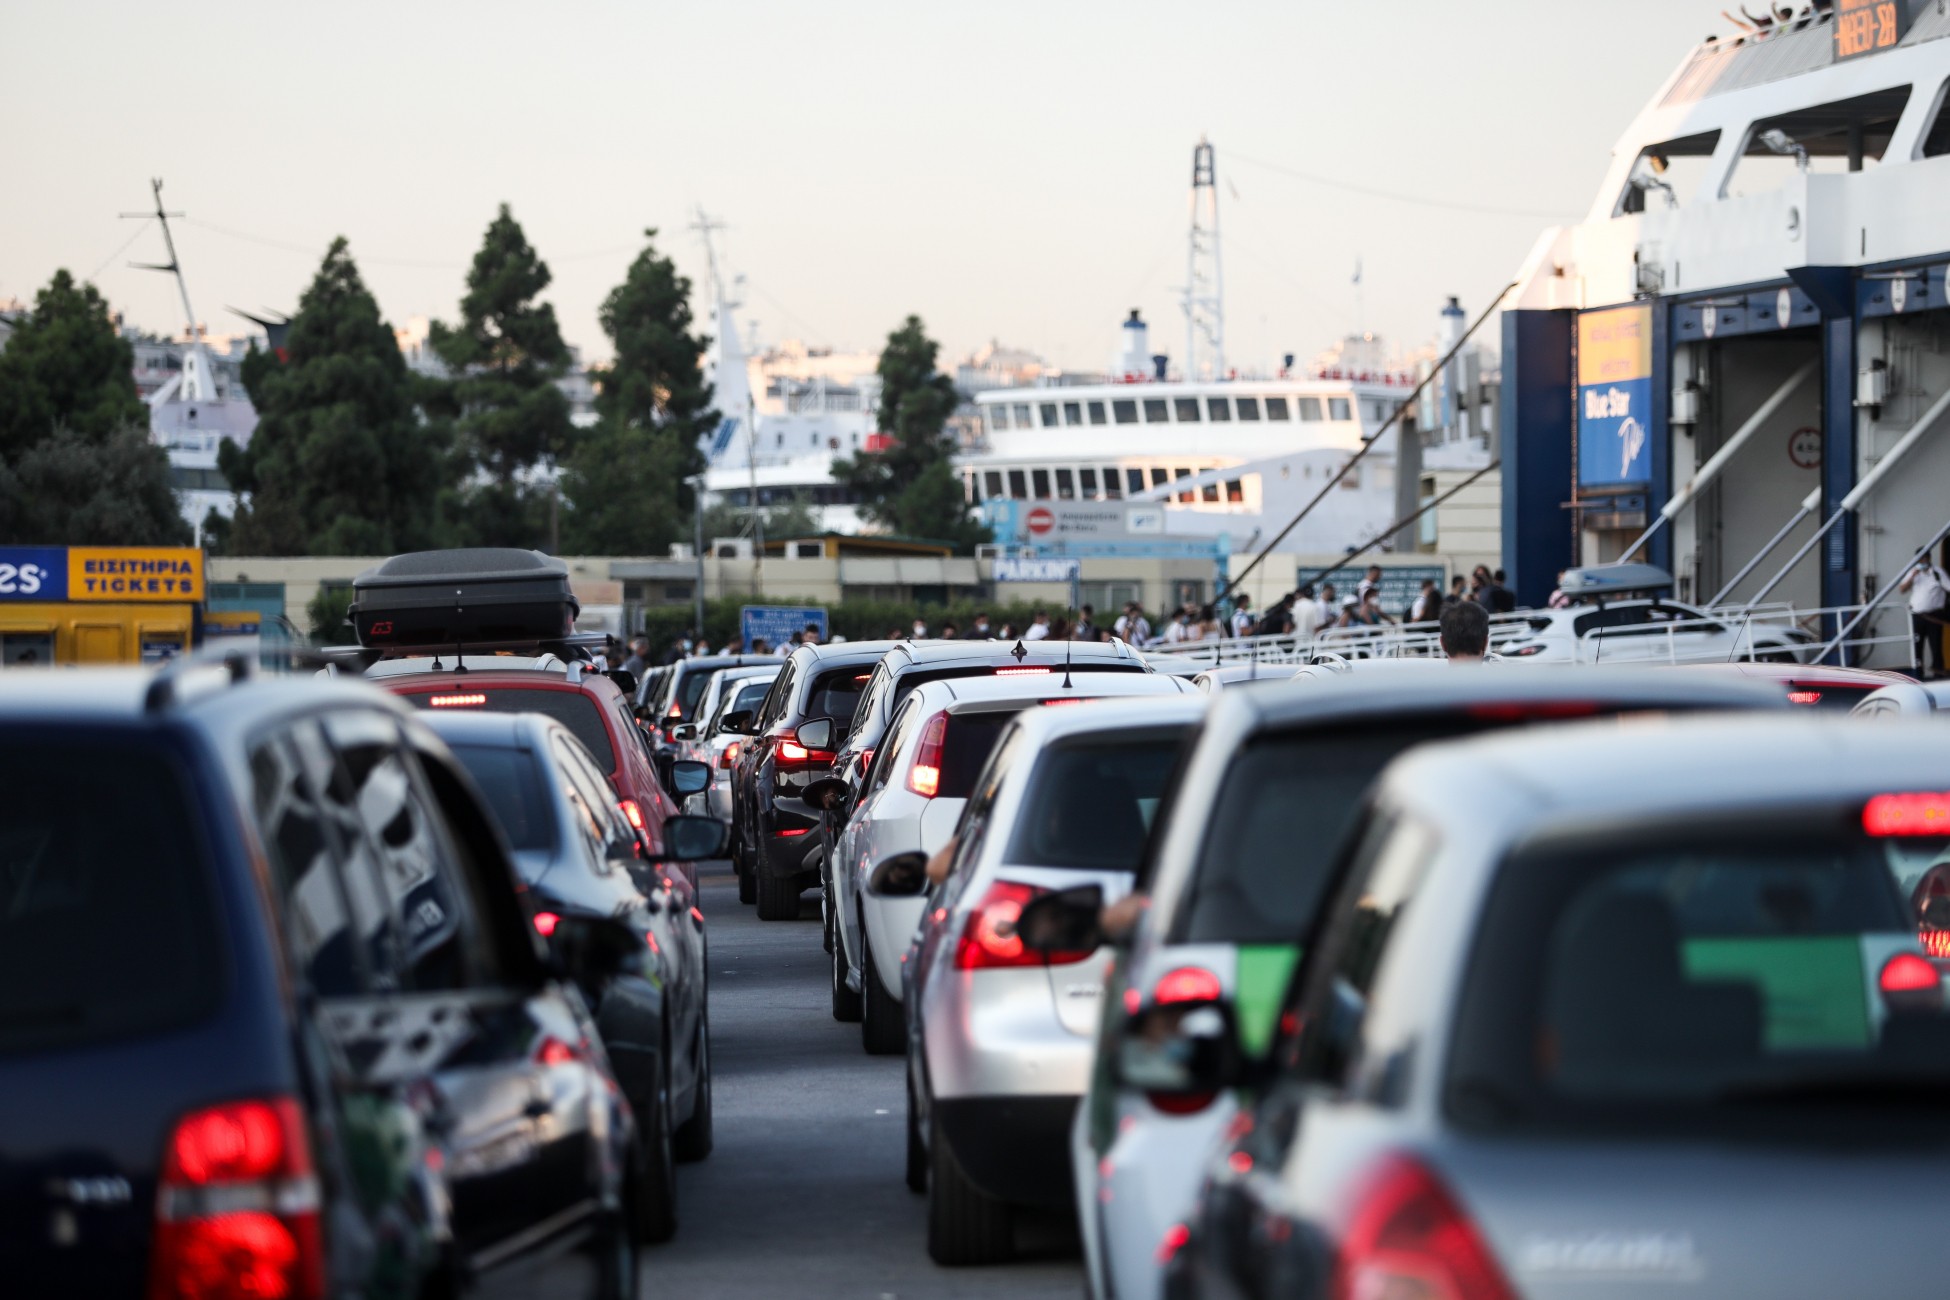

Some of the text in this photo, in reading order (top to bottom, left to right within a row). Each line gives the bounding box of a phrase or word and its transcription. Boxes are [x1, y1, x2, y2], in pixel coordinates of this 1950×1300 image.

[1585, 387, 1630, 419] Blue Star
[84, 559, 193, 574] ΕΙΣΙΤΗΡΙΑ
[84, 578, 193, 593] TICKETS
